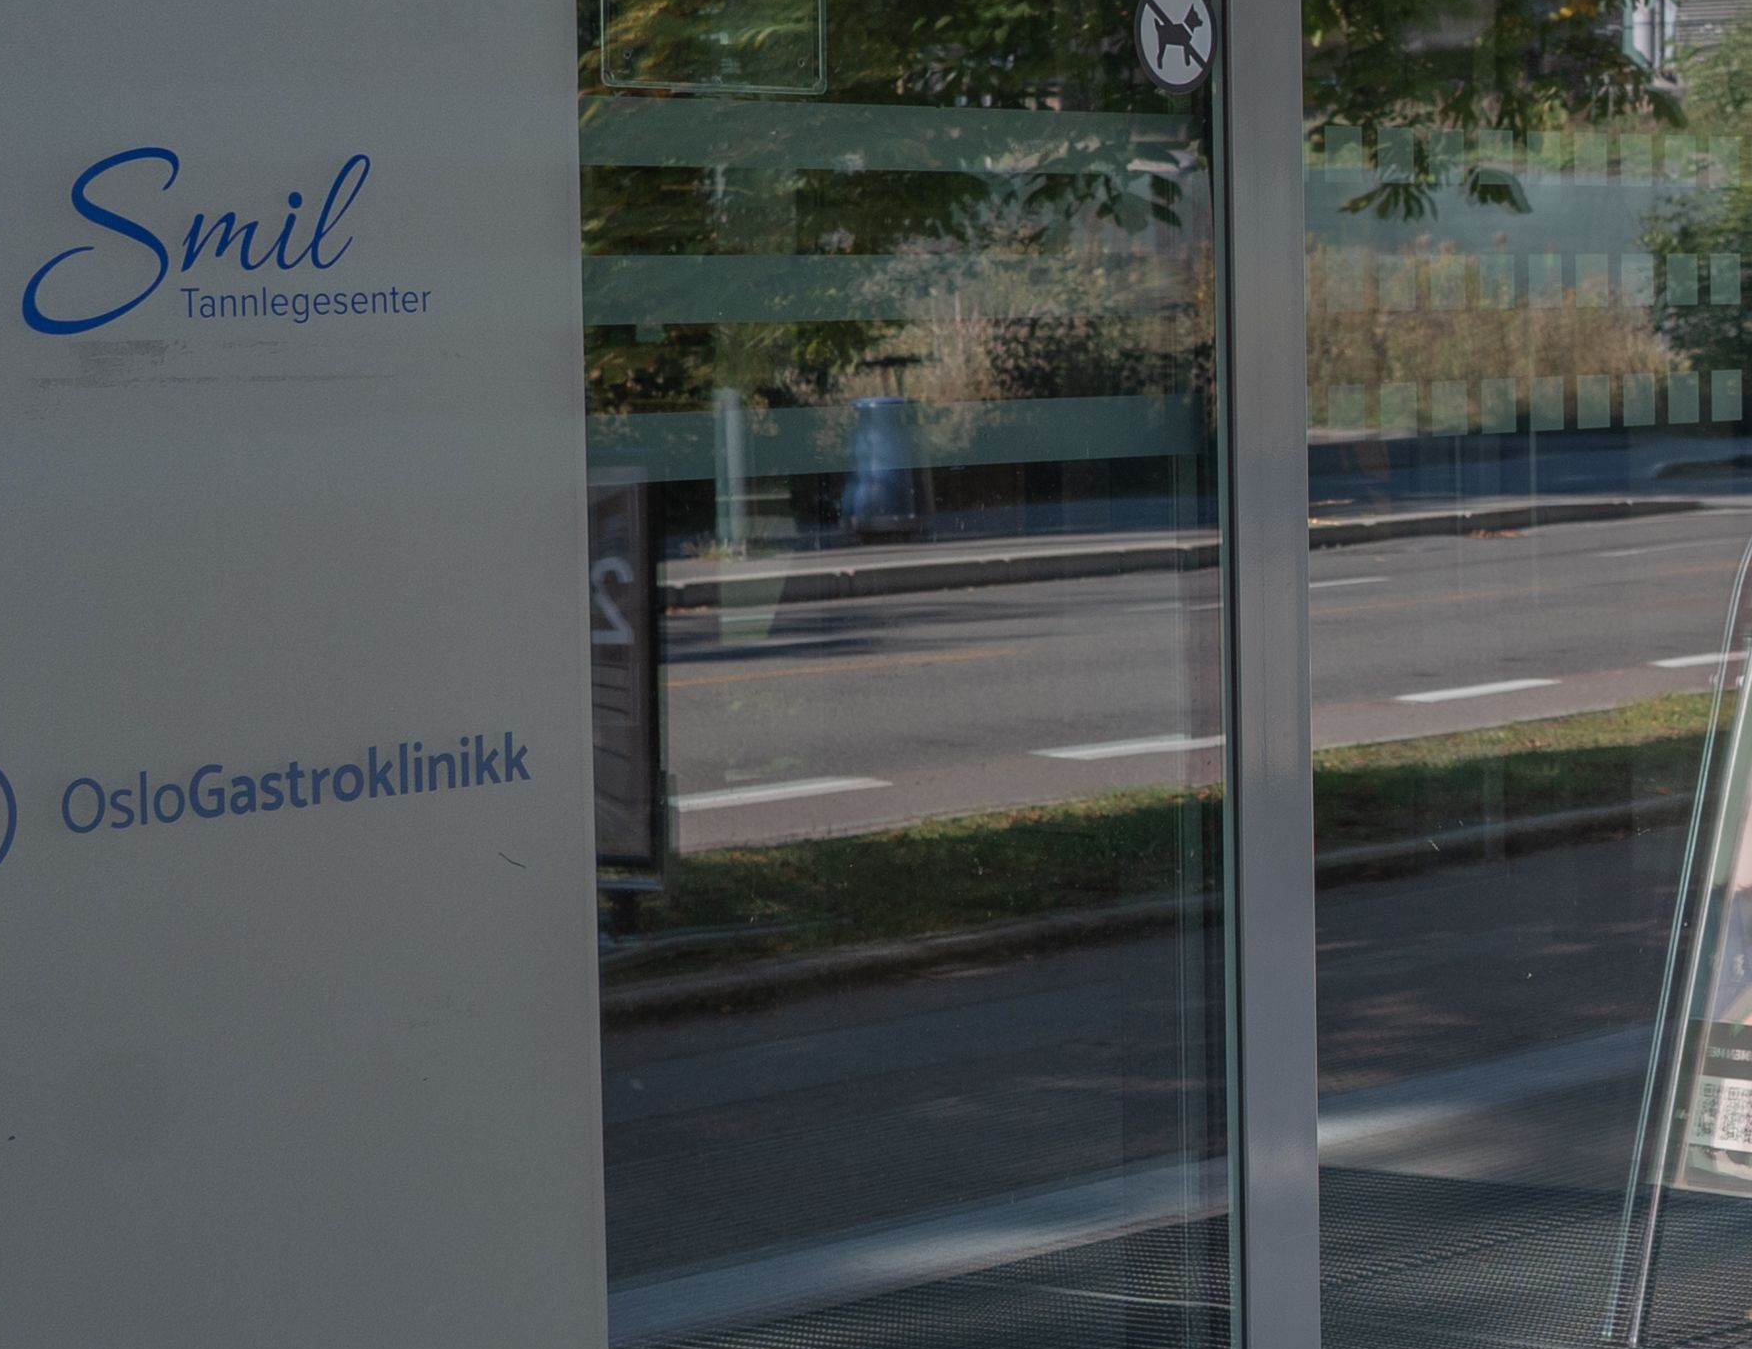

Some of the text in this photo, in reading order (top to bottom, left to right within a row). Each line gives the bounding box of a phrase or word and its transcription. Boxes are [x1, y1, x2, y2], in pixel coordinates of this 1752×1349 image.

[21, 147, 371, 335] Smil
[180, 283, 432, 324] Tannlegesenter
[61, 732, 532, 835] OsloGastroklinikk
